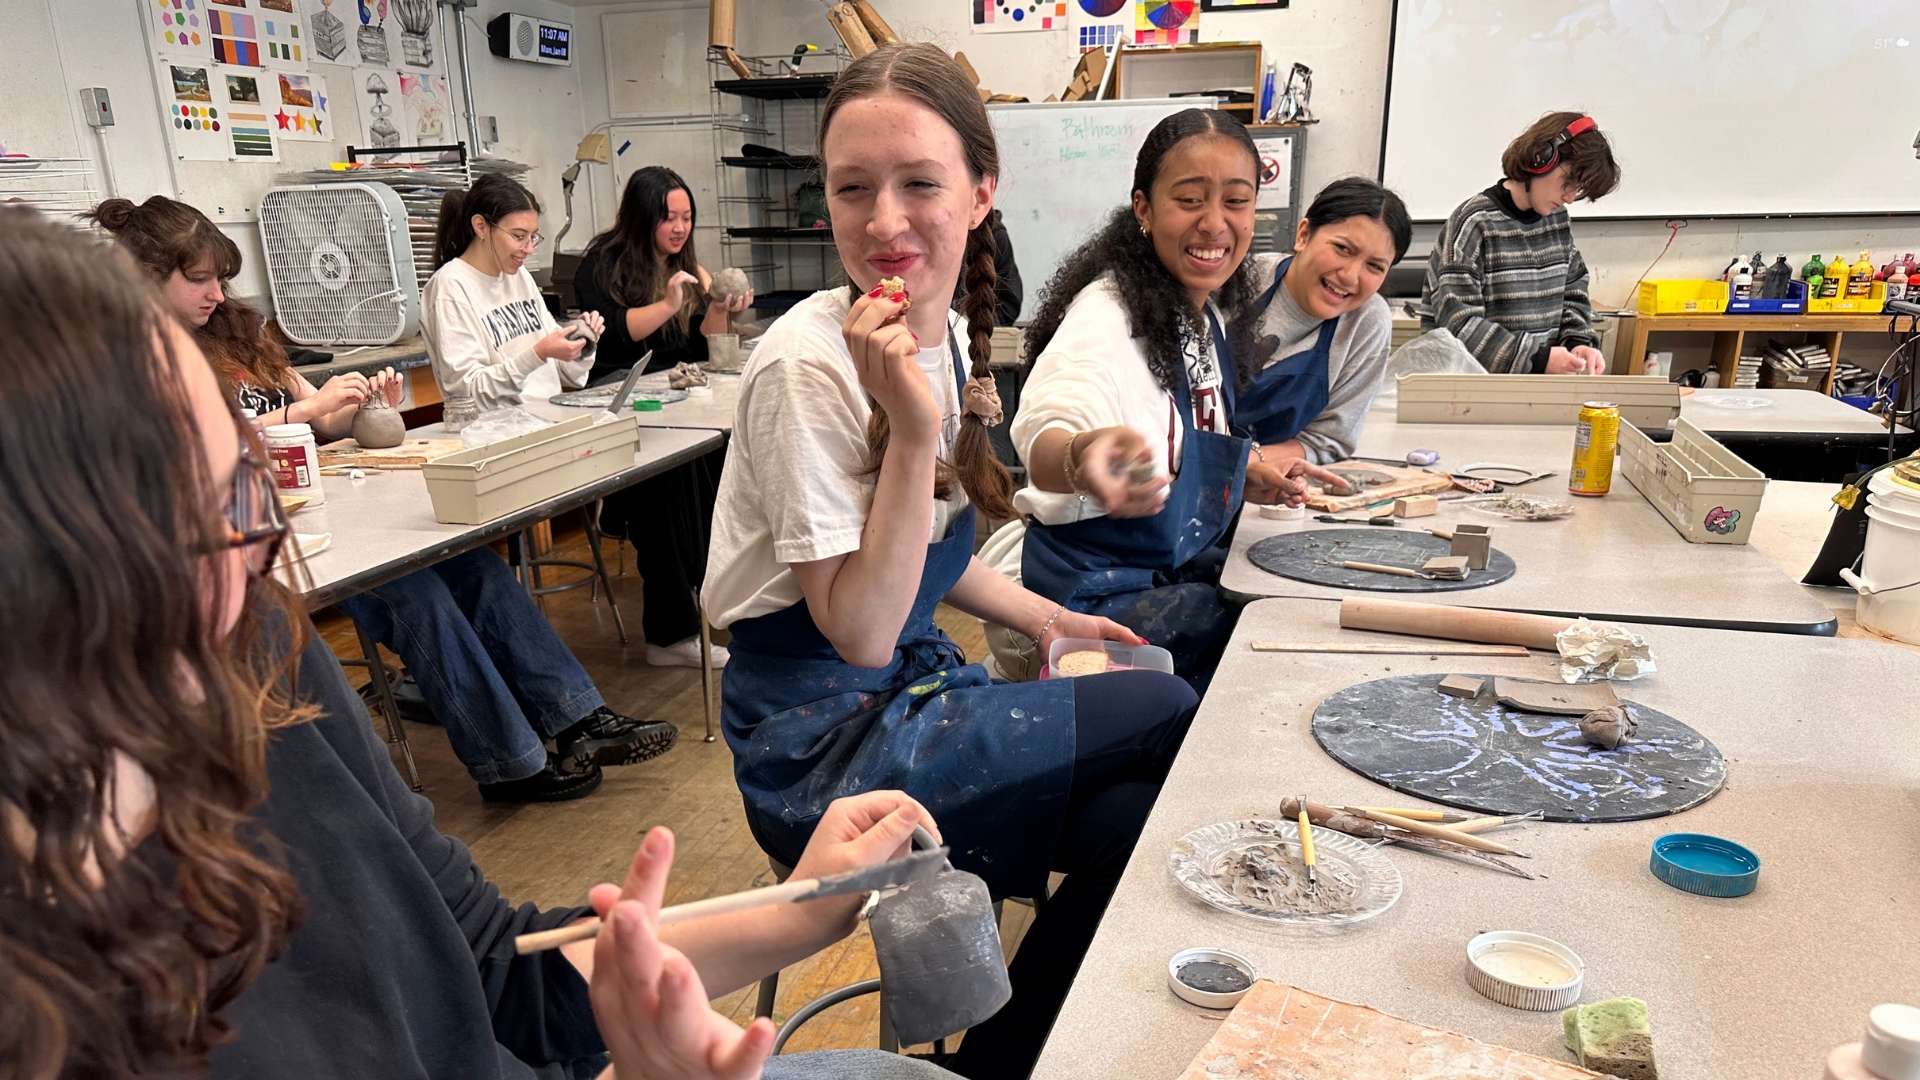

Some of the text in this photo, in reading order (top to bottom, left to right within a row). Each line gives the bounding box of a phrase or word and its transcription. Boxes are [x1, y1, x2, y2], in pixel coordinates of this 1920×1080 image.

[540, 27, 568, 42] 11:07 AM
[1061, 115, 1133, 140] Bathroom
